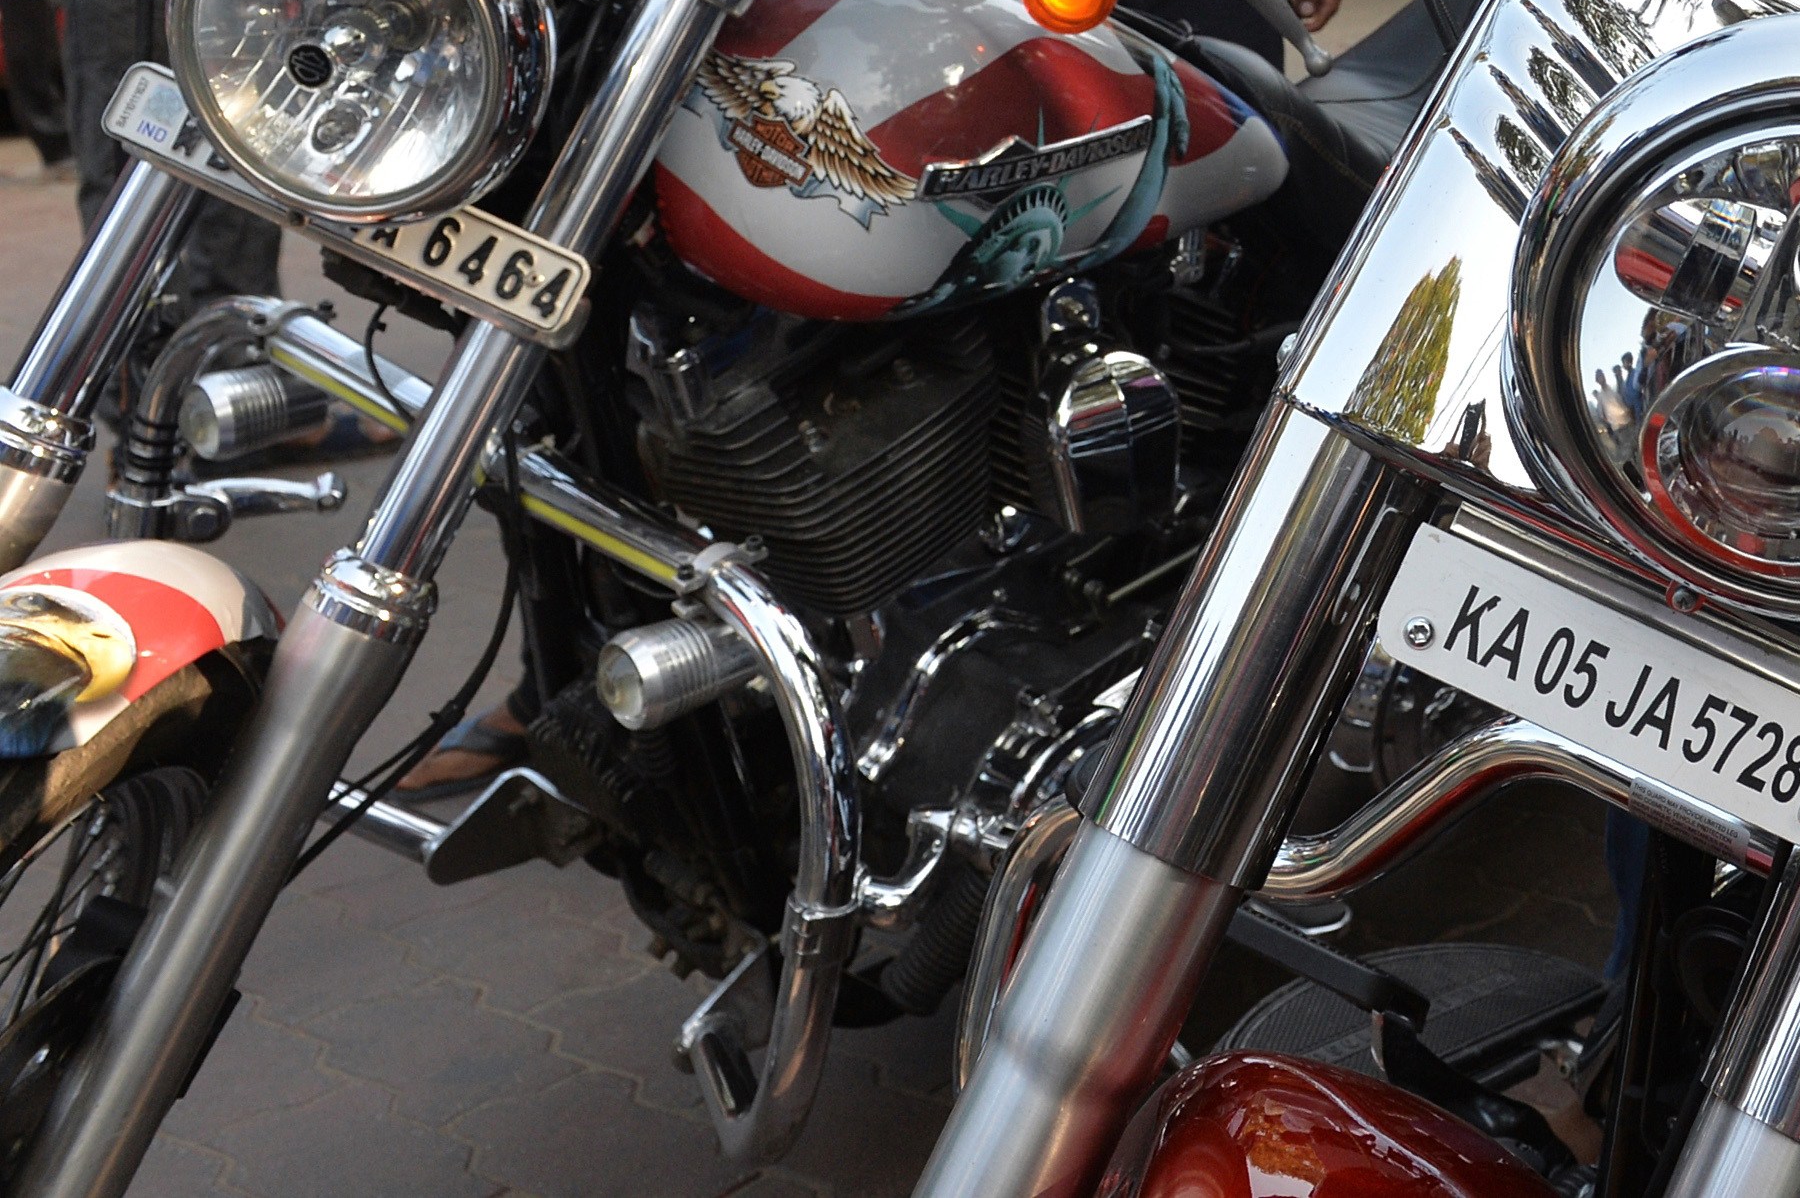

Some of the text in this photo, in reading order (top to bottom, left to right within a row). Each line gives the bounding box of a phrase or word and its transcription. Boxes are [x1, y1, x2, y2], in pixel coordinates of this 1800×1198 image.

[137, 119, 168, 143] IND
[422, 216, 573, 319] 6464
[1444, 585, 1530, 682] KA
[1534, 627, 1611, 709] 05
[1605, 665, 1681, 751] JA
